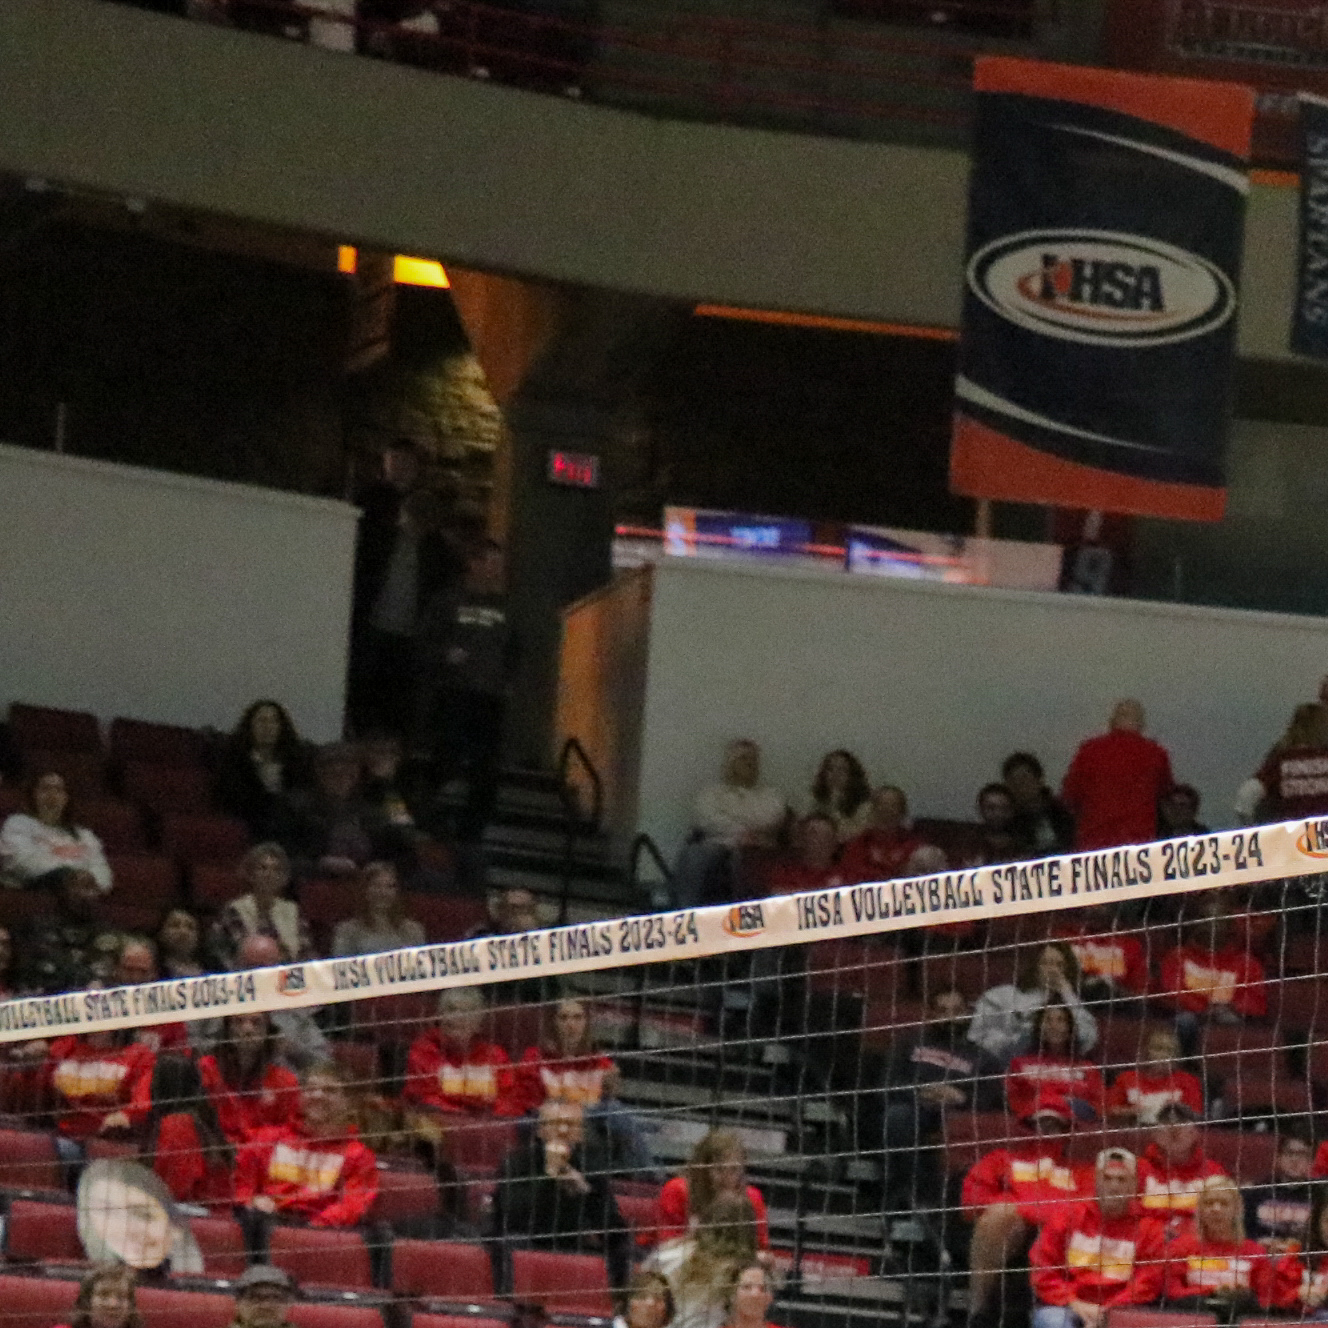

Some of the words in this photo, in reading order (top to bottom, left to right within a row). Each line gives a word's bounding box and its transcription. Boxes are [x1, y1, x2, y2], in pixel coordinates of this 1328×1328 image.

[1040, 253, 1164, 313] IHSA
[797, 891, 844, 931] IHSA
[851, 871, 985, 923] VOLLEYBALL
[991, 860, 1063, 904] STATE
[1069, 846, 1153, 894] FINALS
[1160, 831, 1265, 881] 2023-24
[332, 958, 371, 991] IHSA
[374, 944, 481, 986] VOLLEYBALL
[486, 935, 541, 971] STATE
[549, 925, 614, 961] FINALS
[618, 911, 700, 953] 2023-24
[0, 996, 81, 1032] OLLEYBALL
[84, 988, 129, 1022] STATE
[135, 979, 188, 1016] FINALS
[192, 973, 257, 1009] 2023-24
